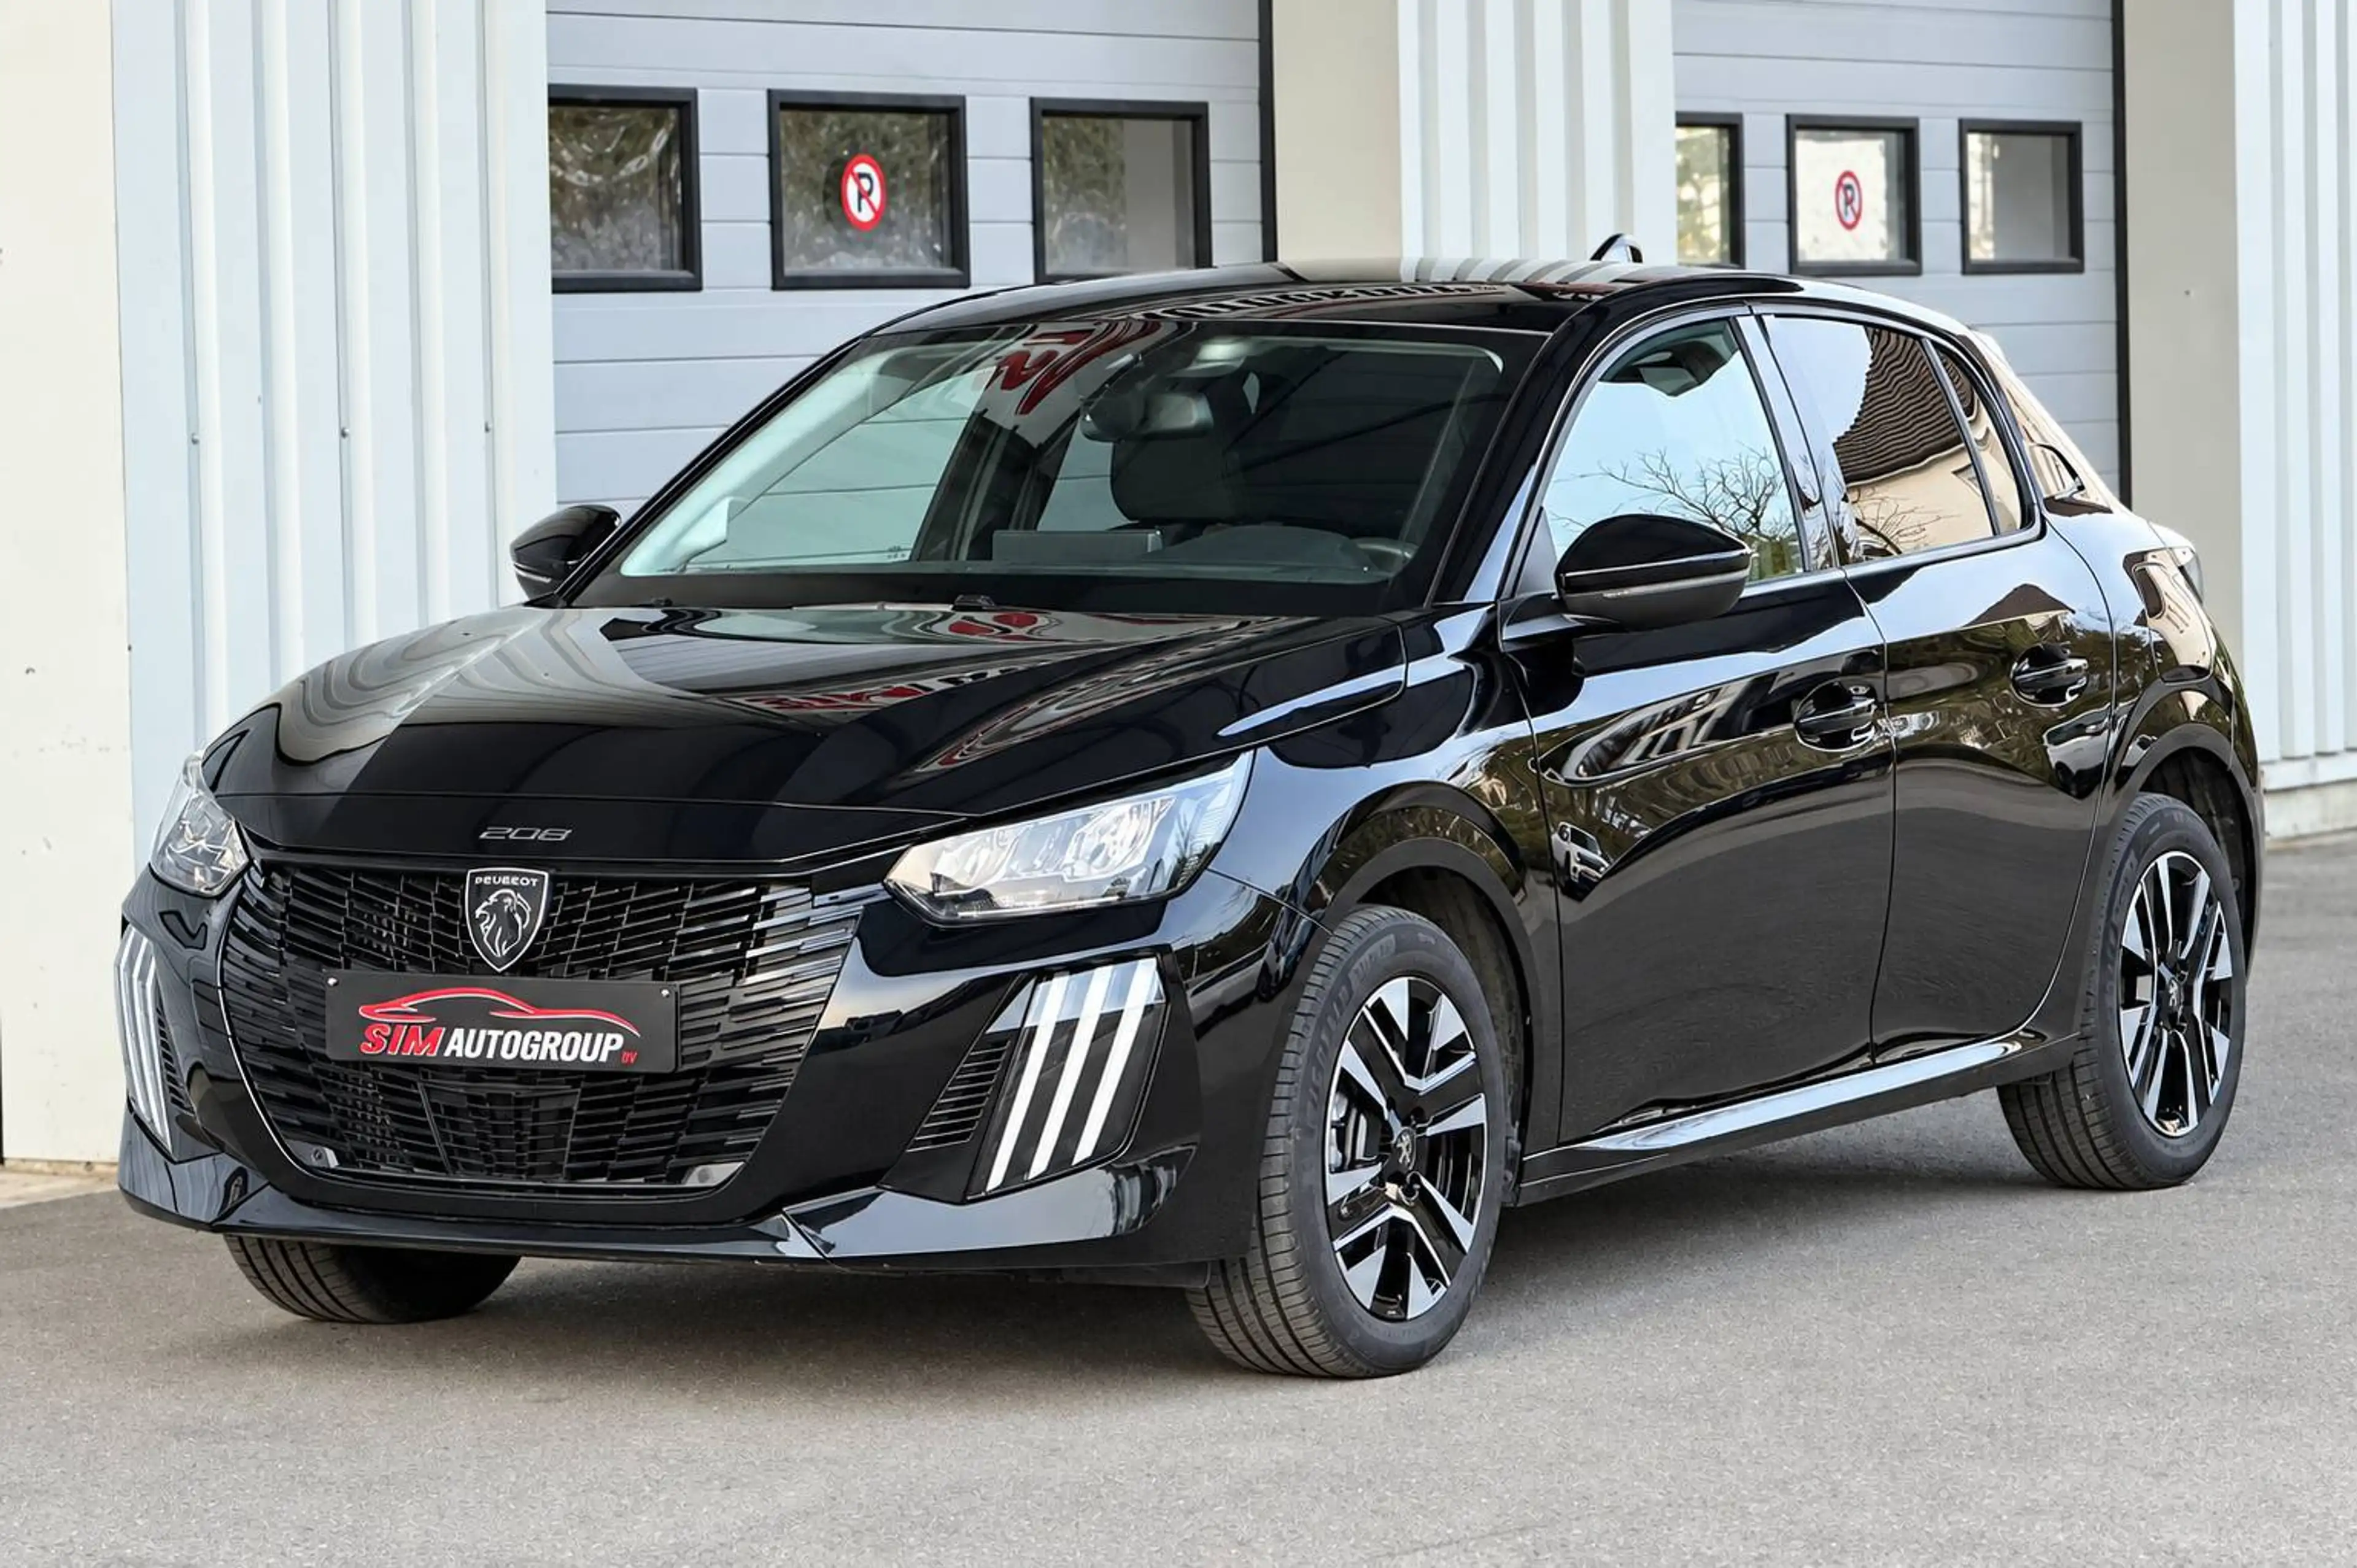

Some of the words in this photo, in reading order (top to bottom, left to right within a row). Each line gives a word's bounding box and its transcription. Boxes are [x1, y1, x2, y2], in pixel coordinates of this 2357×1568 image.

[857, 172, 873, 213] P
[479, 826, 573, 841] 208
[474, 875, 538, 887] PEUGEOT
[359, 1024, 446, 1057] SIM
[443, 1028, 625, 1064] AUTOGROUP
